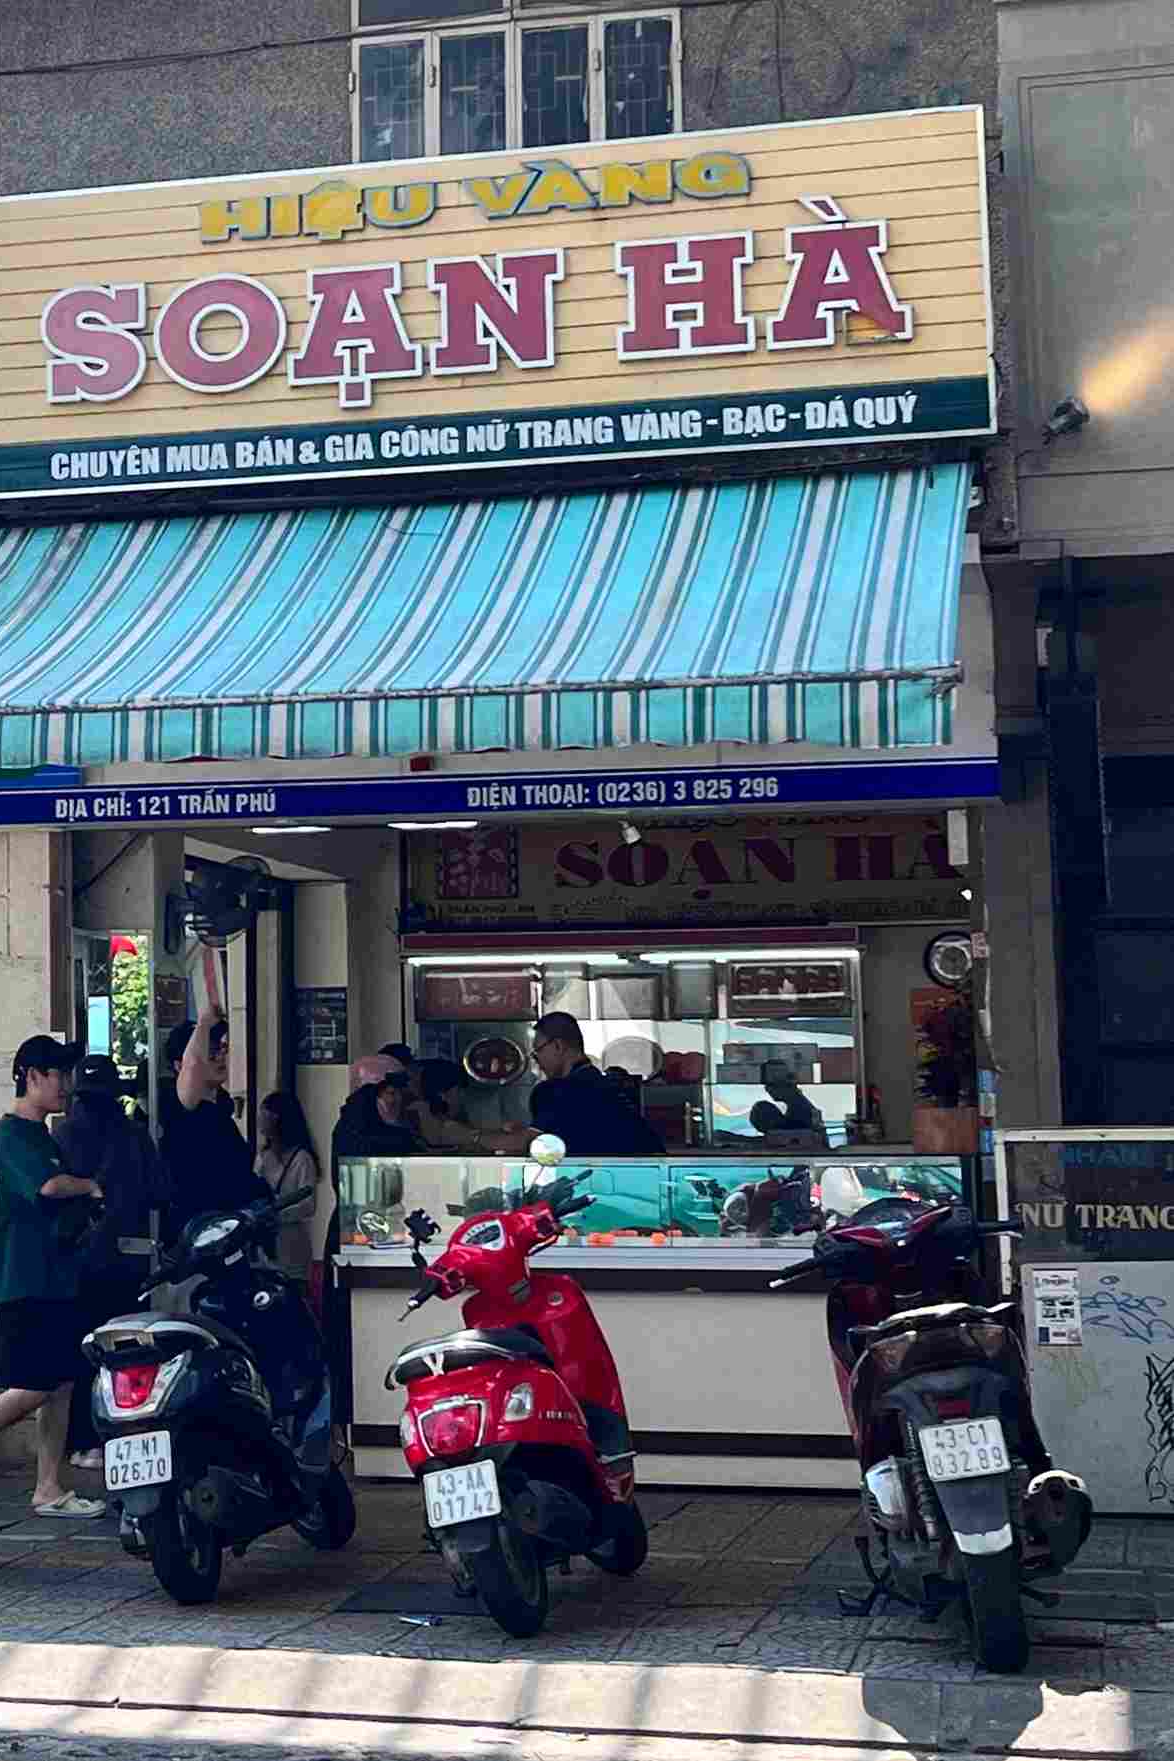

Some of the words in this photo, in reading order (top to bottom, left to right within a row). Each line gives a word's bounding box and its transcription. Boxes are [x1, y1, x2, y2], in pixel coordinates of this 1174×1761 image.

[463, 151, 751, 220] VÀNG
[40, 248, 564, 408] SOẠN
[616, 196, 913, 361] HÀ
[50, 445, 159, 481] CHUYÊN
[166, 443, 229, 473] MUA
[235, 434, 295, 468] BÁN
[298, 440, 321, 464] &
[324, 433, 374, 462] GIA
[380, 424, 461, 458] CÔNG
[466, 417, 511, 452] NỮ
[515, 416, 614, 449] TRANG
[621, 408, 702, 442] VÀNG
[723, 403, 786, 437] BẠC
[805, 395, 849, 430] ĐÁ
[853, 390, 918, 430] QUÝ
[137, 796, 170, 815] 121
[236, 788, 276, 813] PHÚ
[467, 783, 516, 810] ĐIỆN
[597, 780, 666, 805] (0236)
[674, 780, 686, 800] 3
[693, 779, 732, 800] 825
[739, 777, 778, 798] 296
[110, 1457, 166, 1485] 026.70
